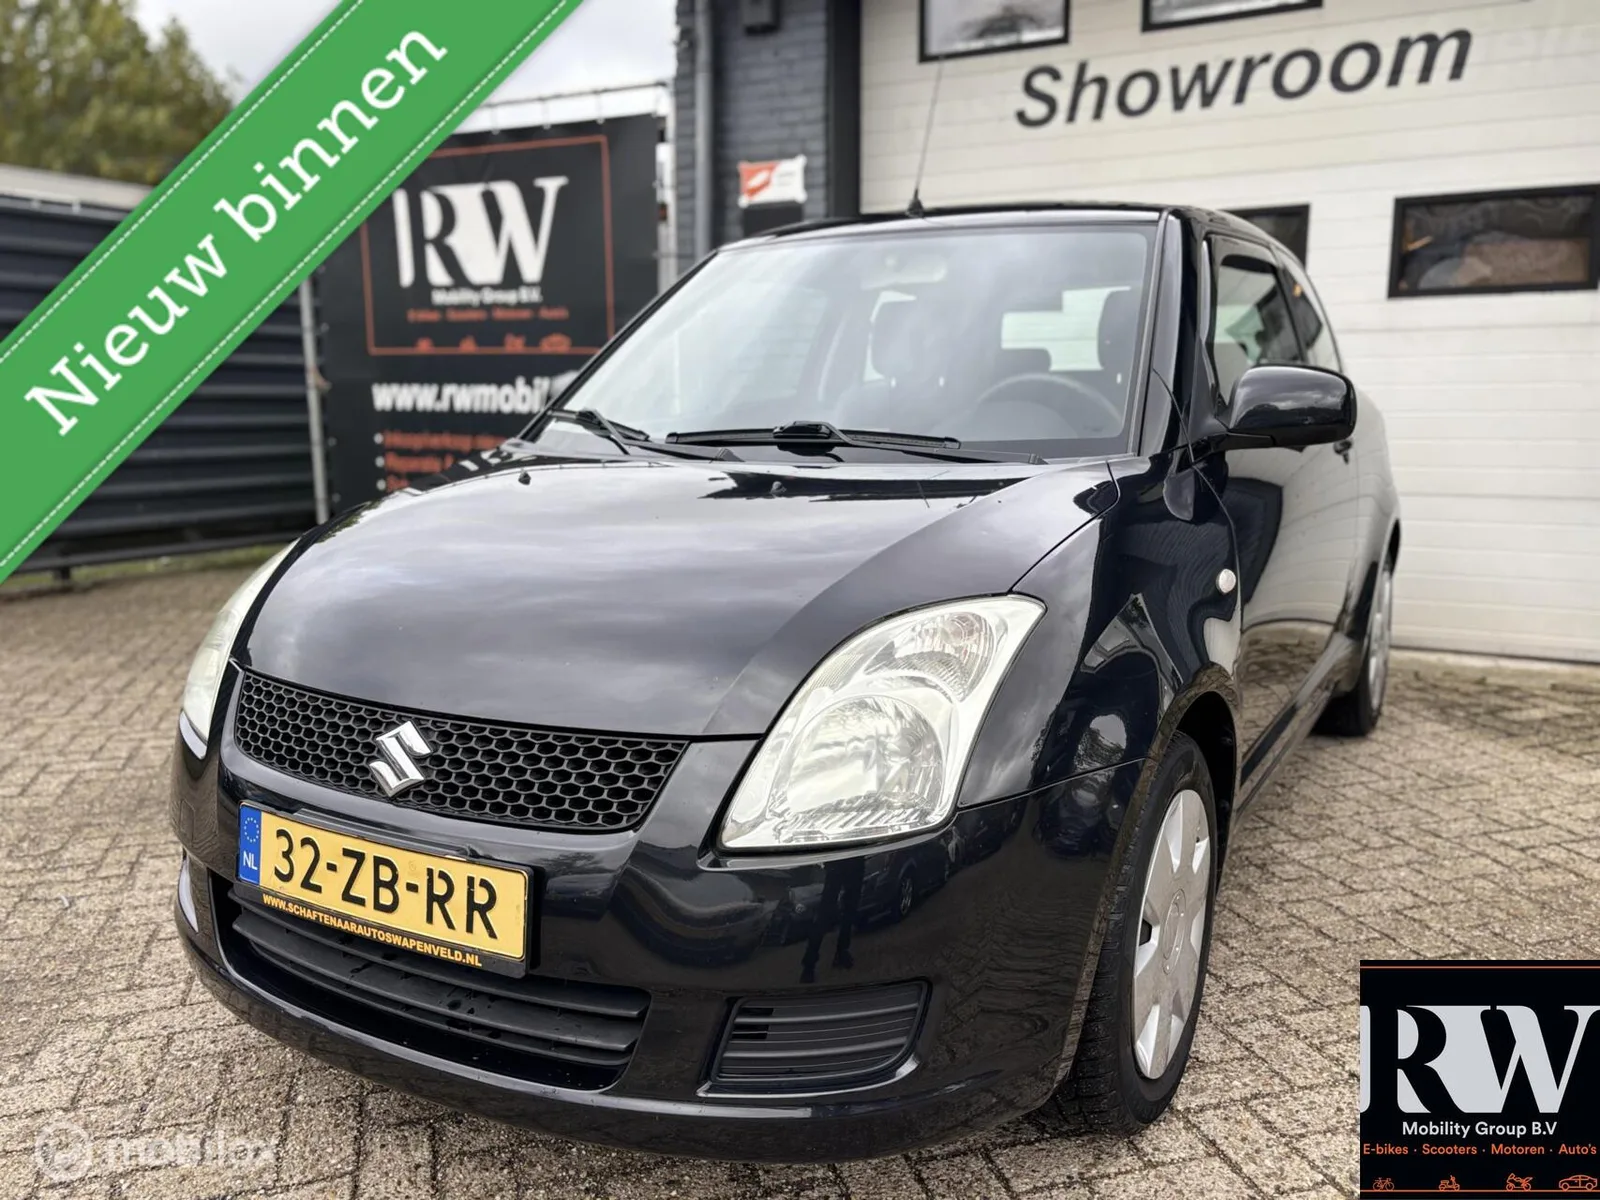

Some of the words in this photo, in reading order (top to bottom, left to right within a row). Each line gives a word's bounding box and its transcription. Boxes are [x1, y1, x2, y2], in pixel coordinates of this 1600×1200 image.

[1014, 28, 1472, 128] Showroom
[393, 176, 568, 287] RW
[242, 850, 258, 871] NL
[273, 828, 499, 940] 32-ZB-RR
[263, 893, 483, 967] WWW.SCHAFTENAARAUTOSWAPENVELD.NL
